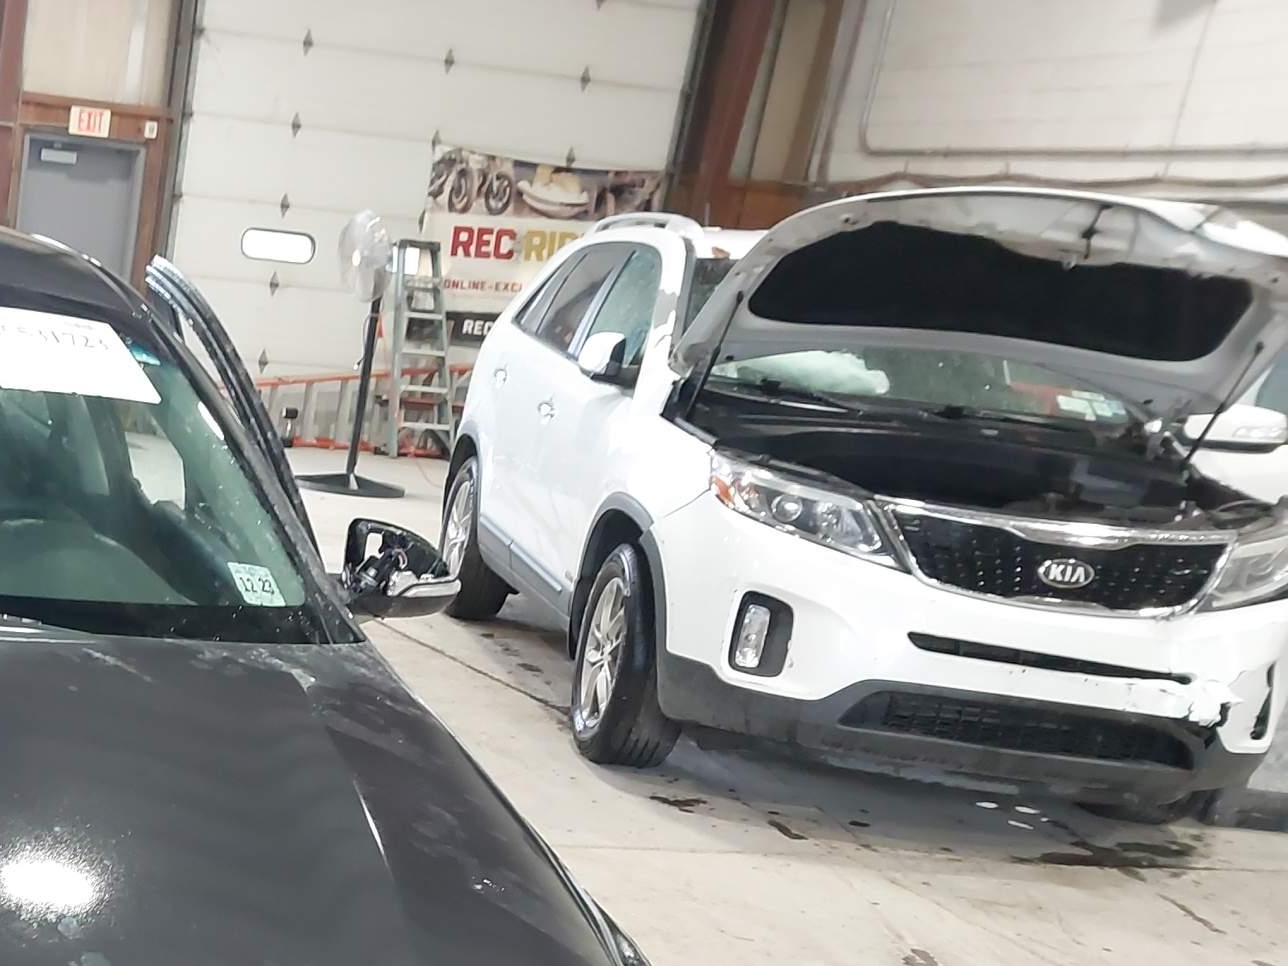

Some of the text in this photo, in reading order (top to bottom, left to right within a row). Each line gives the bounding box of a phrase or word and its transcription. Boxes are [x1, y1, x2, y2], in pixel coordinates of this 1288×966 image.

[78, 109, 104, 133] EXIT
[450, 225, 517, 260] REC
[1048, 563, 1086, 583] KIA
